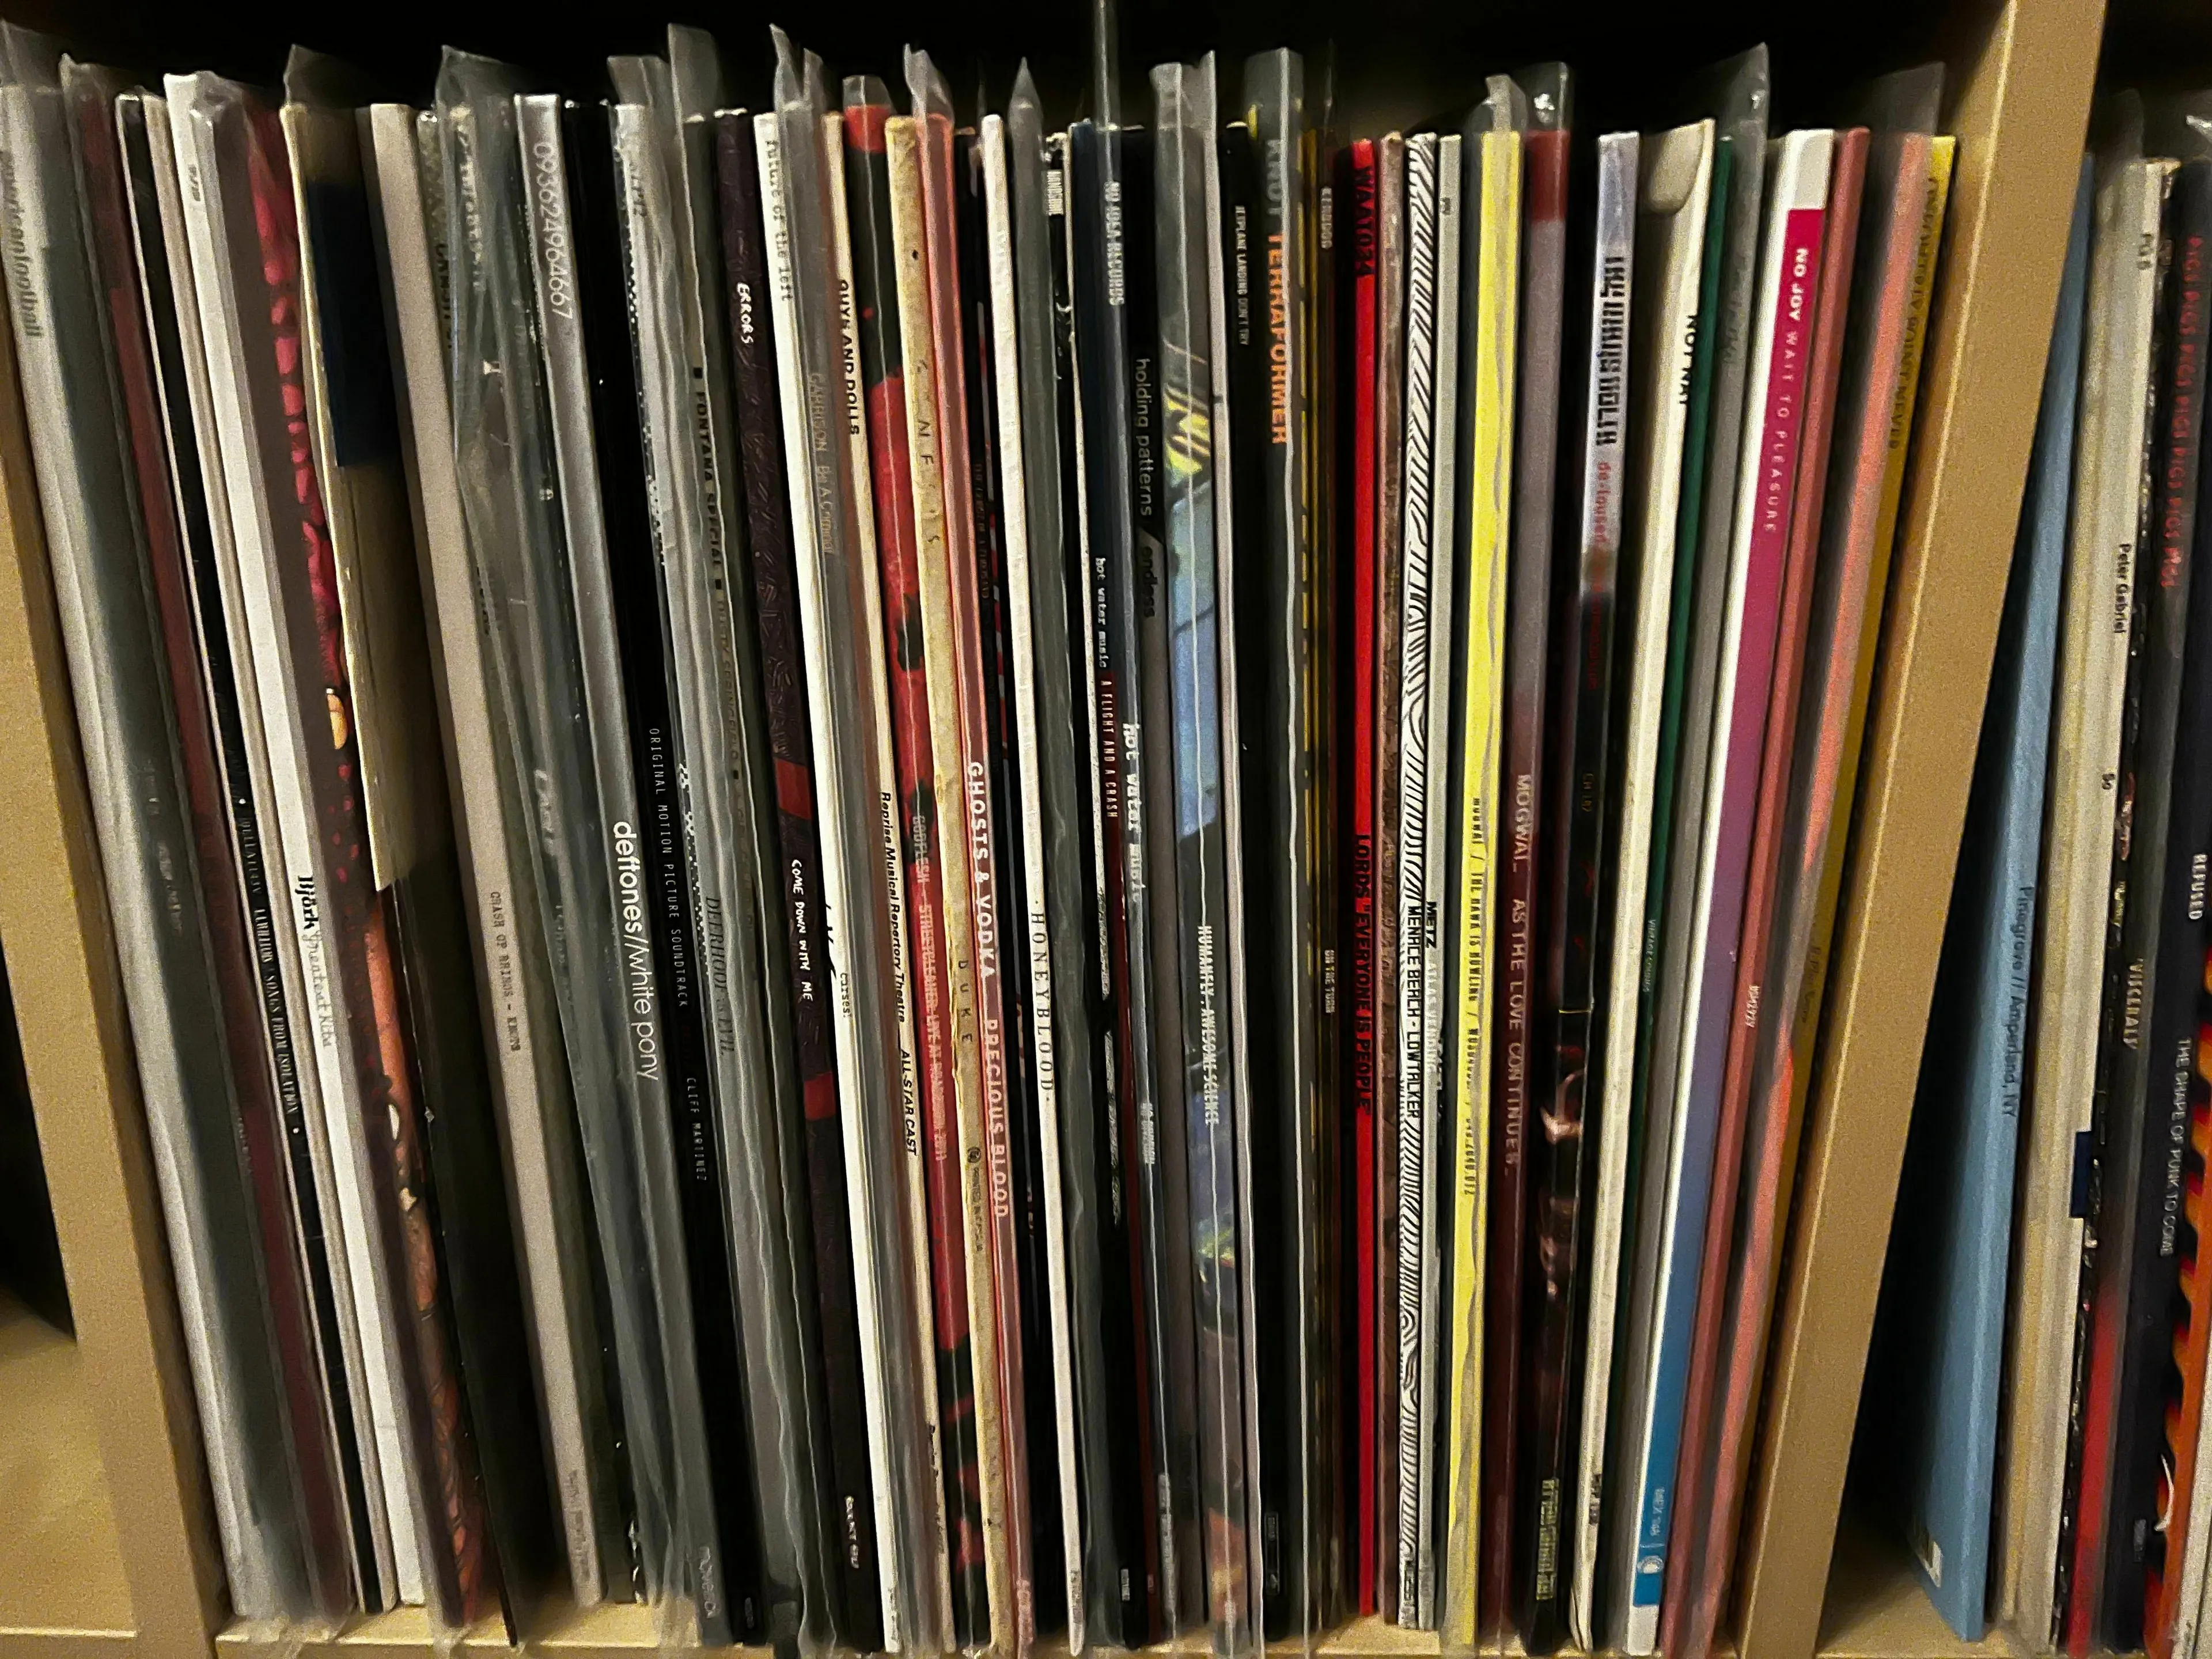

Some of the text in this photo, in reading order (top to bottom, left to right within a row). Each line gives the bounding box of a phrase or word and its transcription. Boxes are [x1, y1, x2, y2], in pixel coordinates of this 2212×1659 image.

[533, 142, 571, 321] 093624964667
[764, 139, 794, 302] future of the left
[1234, 205, 1247, 249] JETPLANE
[1236, 253, 1248, 294] LANDING
[2182, 234, 2205, 285] PIGS
[736, 282, 754, 344] ERRORS
[1267, 232, 1290, 444] TERRAFORMER
[2178, 290, 2202, 337] PIGS
[840, 335, 855, 374] AND
[2175, 342, 2198, 389] PIGS
[843, 378, 861, 435] DOLLS
[1763, 247, 1809, 532] NO JOY WAIT TO PLEASURE
[2171, 394, 2194, 440] PIGS
[694, 391, 715, 480] FONTANA
[1128, 358, 1153, 516] holding patterns
[2166, 445, 2190, 490] PIGS
[2162, 495, 2186, 539] PIGS
[1094, 556, 1109, 668] hot water music
[1137, 546, 1156, 618] endless
[2112, 543, 2133, 634] Peter Gabriel
[1100, 693, 1114, 733] FLIGHT
[647, 728, 666, 794] ORIGINAL
[1102, 740, 1115, 762] AND
[657, 805, 673, 854] MOTION
[1105, 782, 1118, 817] CRASH
[1122, 721, 1147, 903] hot water music
[910, 815, 930, 883] GODFLESH
[1355, 834, 1370, 897] LORDS
[293, 873, 320, 929] Björk
[490, 891, 505, 928] CRASH
[662, 863, 680, 918] PICTURE
[1468, 873, 1481, 893] THE
[1512, 899, 1527, 924] AS
[2186, 851, 2209, 921] REFUSED
[703, 896, 730, 994] DEERHOOF
[788, 858, 813, 1001] COME DOWN WITH ME
[1426, 902, 1436, 948] METZ
[1510, 933, 1526, 971] THE
[669, 929, 689, 1007] SOUNDTRACK
[879, 792, 917, 1157] Reprise Musical Repertory Theatre ALL-STAR CAST
[1355, 905, 1371, 1010] "EVERYONE
[964, 762, 1012, 1218] GHOSTS & VODKA PRECIOUS BLOOD
[1030, 911, 1055, 1092] HONEYBLOOD
[1406, 906, 1421, 1118] MENACE BEACH LOWTALKER
[1508, 981, 1524, 1030] LOVE
[1998, 884, 2035, 1118] Pinegrove Amperland, NY
[630, 1021, 660, 1082] pony
[1197, 925, 1218, 1126] HUMANFLY AWESOME SCIENCE
[1355, 1018, 1371, 1032] IS
[686, 1077, 700, 1114] CLIFF
[690, 1123, 707, 1181] MARTINEZ
[2158, 1037, 2191, 1257] THE SHAPE OF PUNK TO COME
